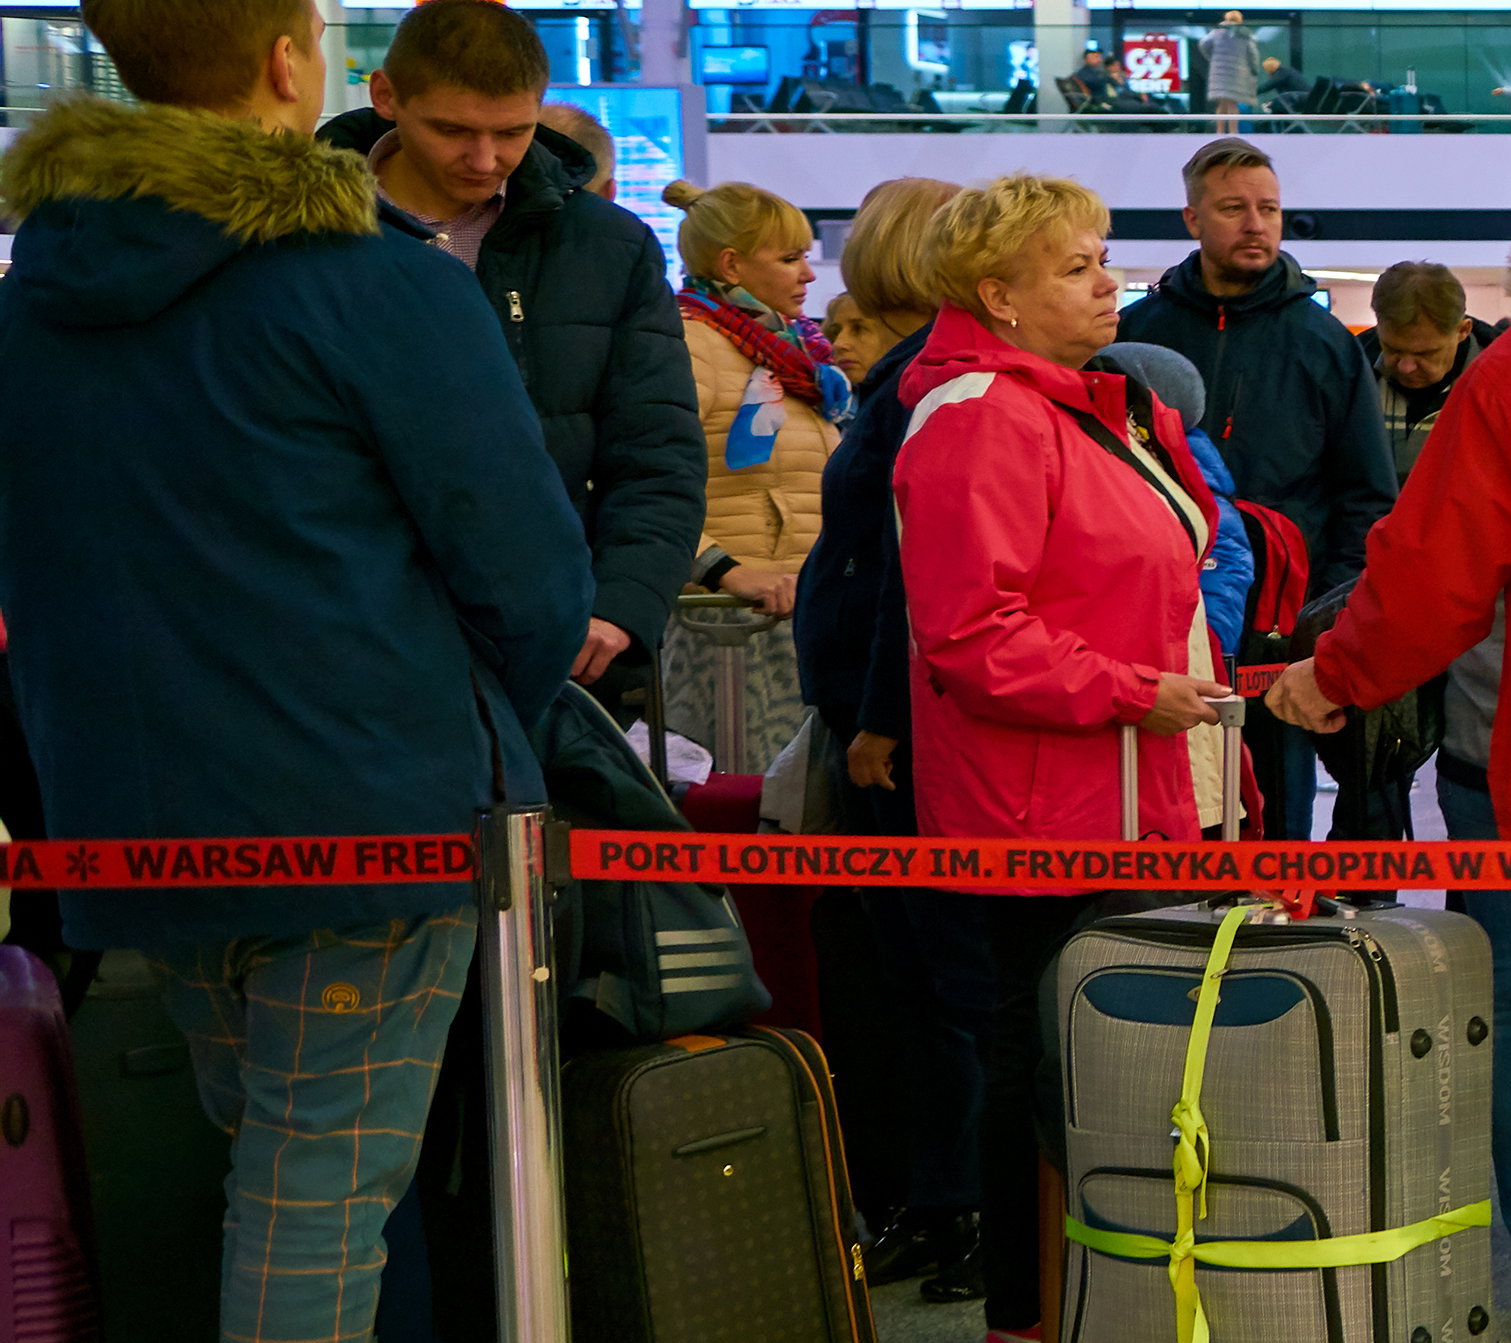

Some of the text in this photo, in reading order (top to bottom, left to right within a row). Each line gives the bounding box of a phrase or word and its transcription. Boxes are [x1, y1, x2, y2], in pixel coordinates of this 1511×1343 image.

[122, 841, 338, 881] WARSAW
[601, 842, 706, 873] PORT
[719, 844, 918, 877] LOTNICZY
[932, 848, 992, 878] IM.
[1007, 849, 1241, 881] FRYDERYKA
[1251, 851, 1435, 882] CHOPINA
[1448, 852, 1488, 880] W
[1437, 1013, 1452, 1127] WISDOM
[1438, 1166, 1452, 1278] WISOM
